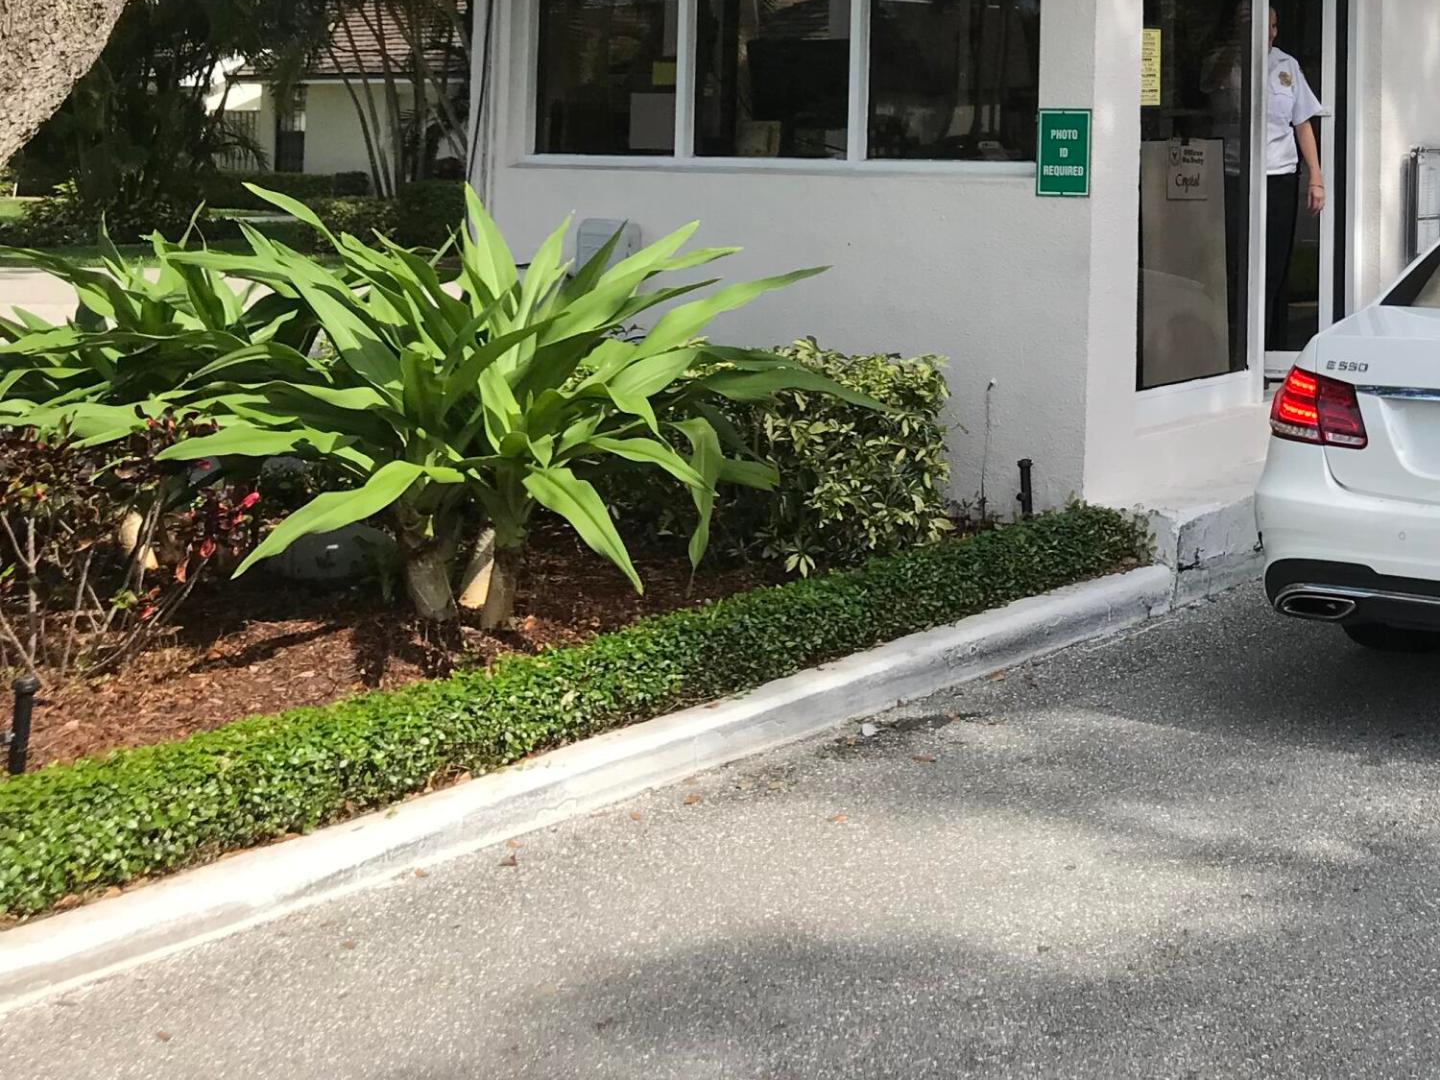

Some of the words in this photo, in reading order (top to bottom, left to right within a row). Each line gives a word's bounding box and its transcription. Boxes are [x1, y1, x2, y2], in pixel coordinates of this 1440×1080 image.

[1050, 129, 1078, 140] PHOTO
[1059, 147, 1068, 158] ID
[1043, 165, 1084, 176] REQUIRED
[1326, 360, 1336, 370] E
[1338, 361, 1369, 372] 550
